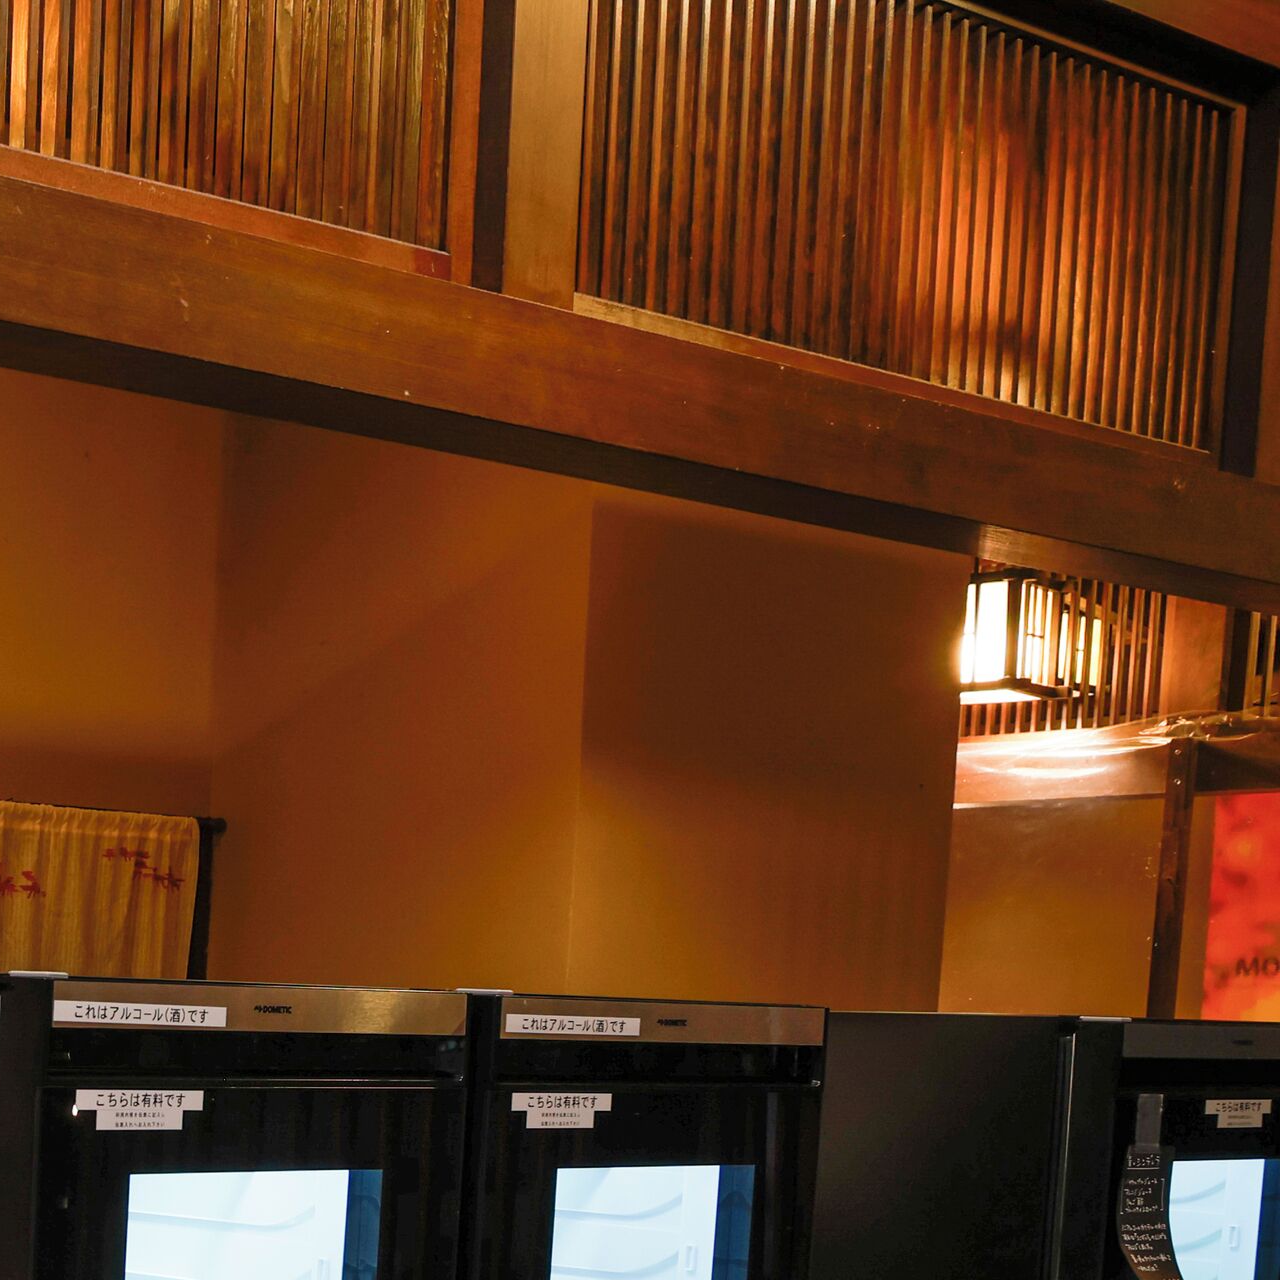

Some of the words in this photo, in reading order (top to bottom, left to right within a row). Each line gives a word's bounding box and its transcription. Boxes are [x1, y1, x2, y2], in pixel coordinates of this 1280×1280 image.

[74, 1004, 209, 1024] これはアルコール(酒)です
[522, 1018, 627, 1033] これはアルコール(酒)です
[96, 1092, 186, 1108] こちらは有料です
[528, 1096, 598, 1109] こちらは有料です
